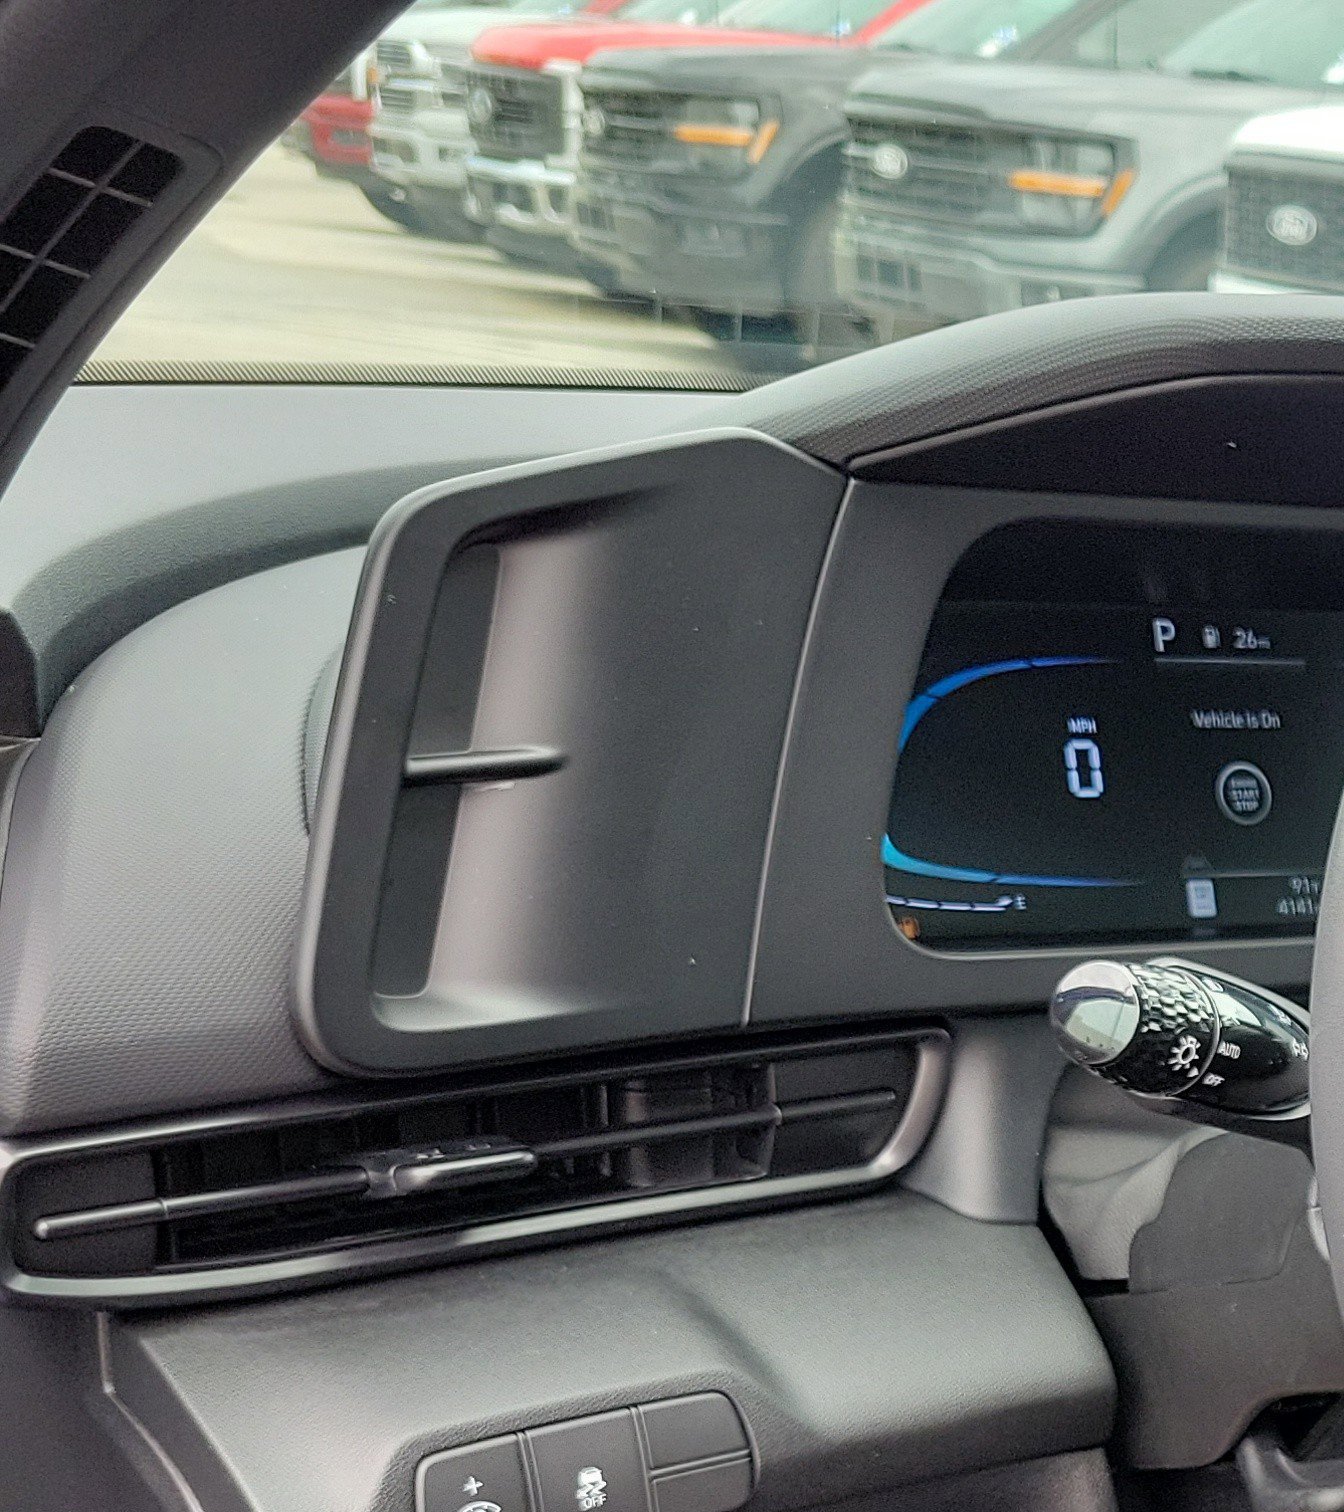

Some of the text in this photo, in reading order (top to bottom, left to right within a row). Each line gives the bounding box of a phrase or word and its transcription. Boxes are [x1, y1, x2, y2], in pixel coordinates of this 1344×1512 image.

[1152, 617, 1176, 652] P
[1067, 717, 1098, 733] MPH
[1191, 709, 1244, 729] Vehicle
[1261, 710, 1281, 729] On
[1063, 738, 1104, 798] 0
[1217, 1040, 1241, 1059] AUTO
[580, 1494, 607, 1511] OFF
